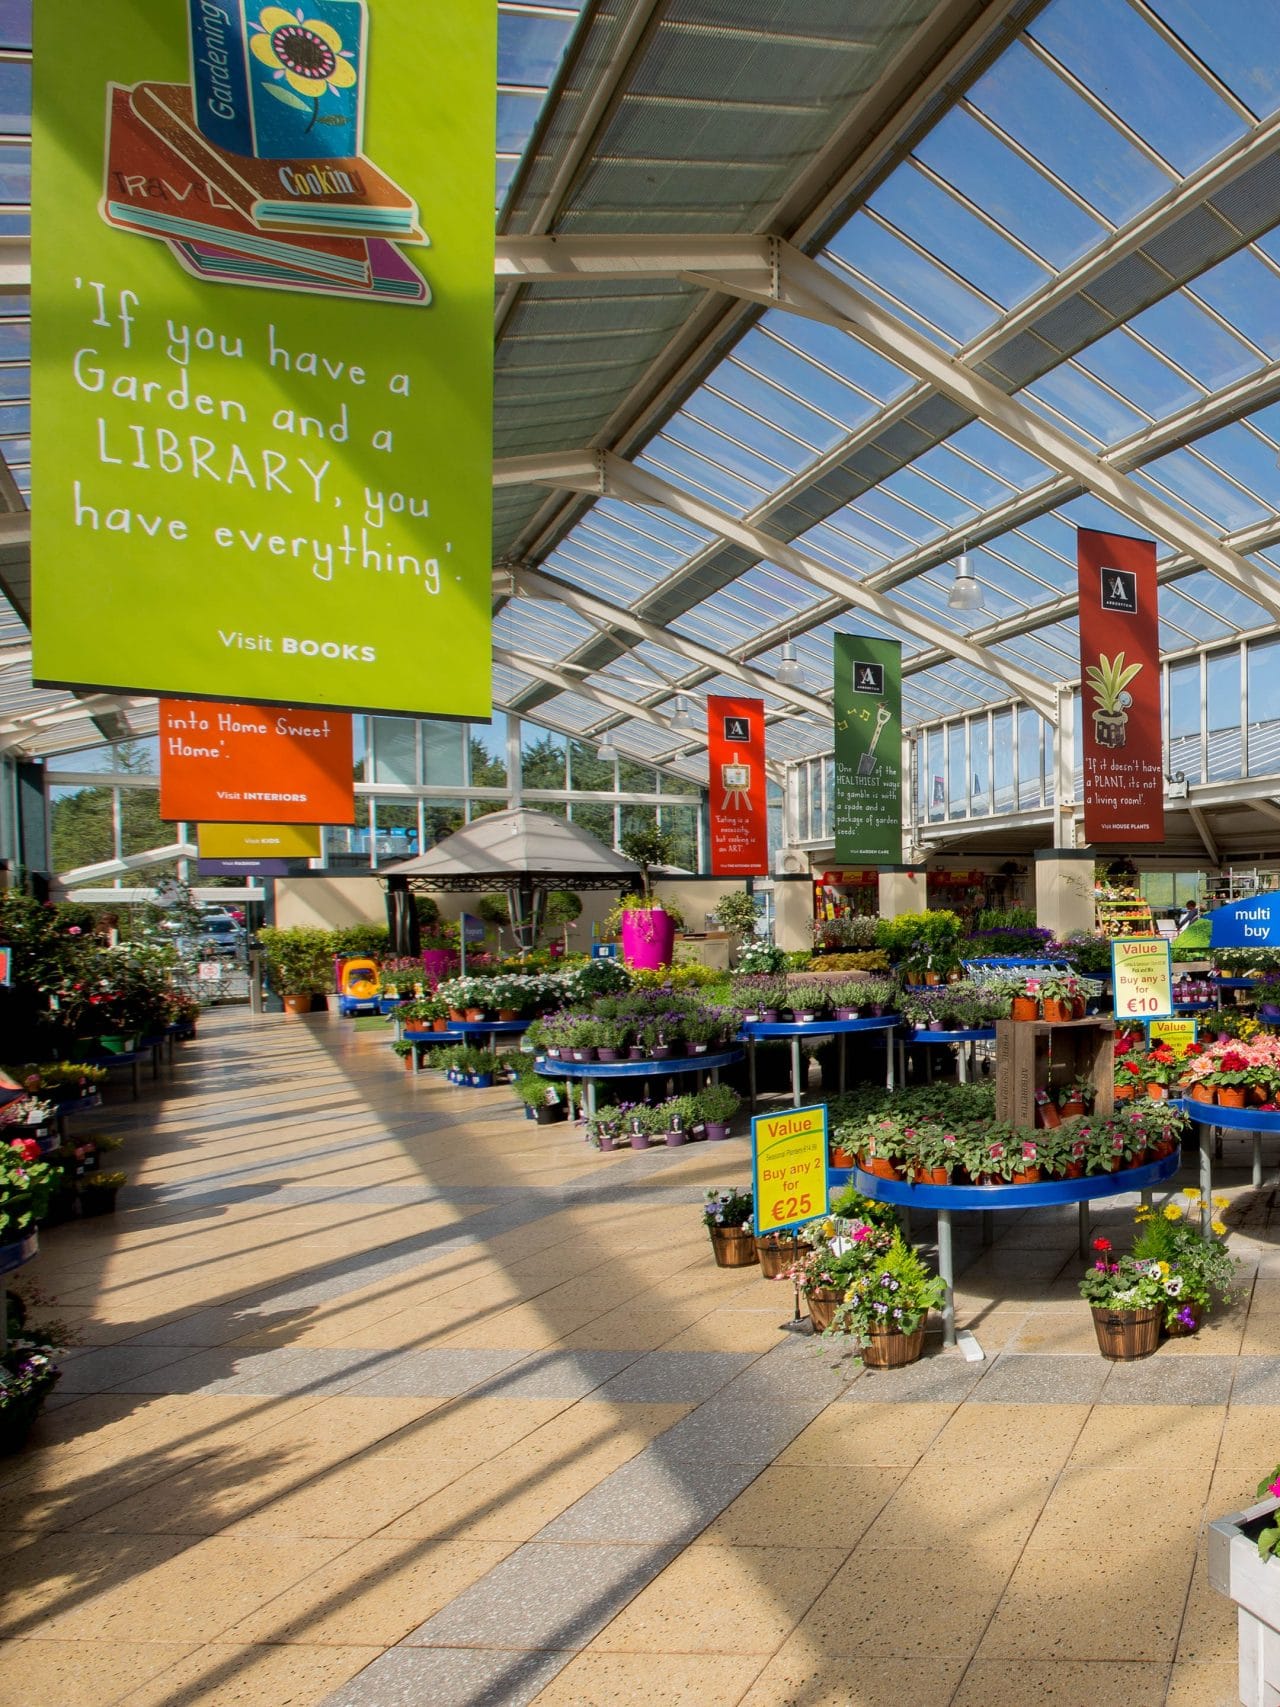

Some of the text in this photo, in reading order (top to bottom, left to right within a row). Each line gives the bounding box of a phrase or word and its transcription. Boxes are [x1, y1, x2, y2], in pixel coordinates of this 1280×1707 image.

[198, 0, 236, 119] Gardening
[167, 320, 243, 364] you
[269, 324, 366, 385] have
[389, 371, 409, 397] a
[73, 348, 393, 452] Garden and a
[98, 418, 429, 527] LIBRARY, you
[73, 481, 188, 541] have
[1110, 576, 1128, 600] A
[218, 629, 376, 662] Visit BOOKS
[168, 711, 331, 738] into Home Sweet
[1100, 759, 1107, 770] it
[1110, 758, 1139, 771] doesn't
[1142, 760, 1161, 772] have
[1094, 775, 1126, 789] PLANT,
[1143, 777, 1156, 789] not
[216, 791, 307, 802] Visit INTERIORS
[1095, 792, 1117, 809] living
[1235, 907, 1271, 920] multi
[1244, 924, 1270, 940] buy
[1122, 944, 1158, 954] Value
[1120, 974, 1166, 985] Buy any 3
[1127, 998, 1158, 1012] €10
[1157, 1022, 1187, 1031] Value
[768, 1119, 812, 1138] Value
[763, 1158, 821, 1182] Buy any 2
[783, 1180, 799, 1192] for
[771, 1193, 812, 1221] €25
